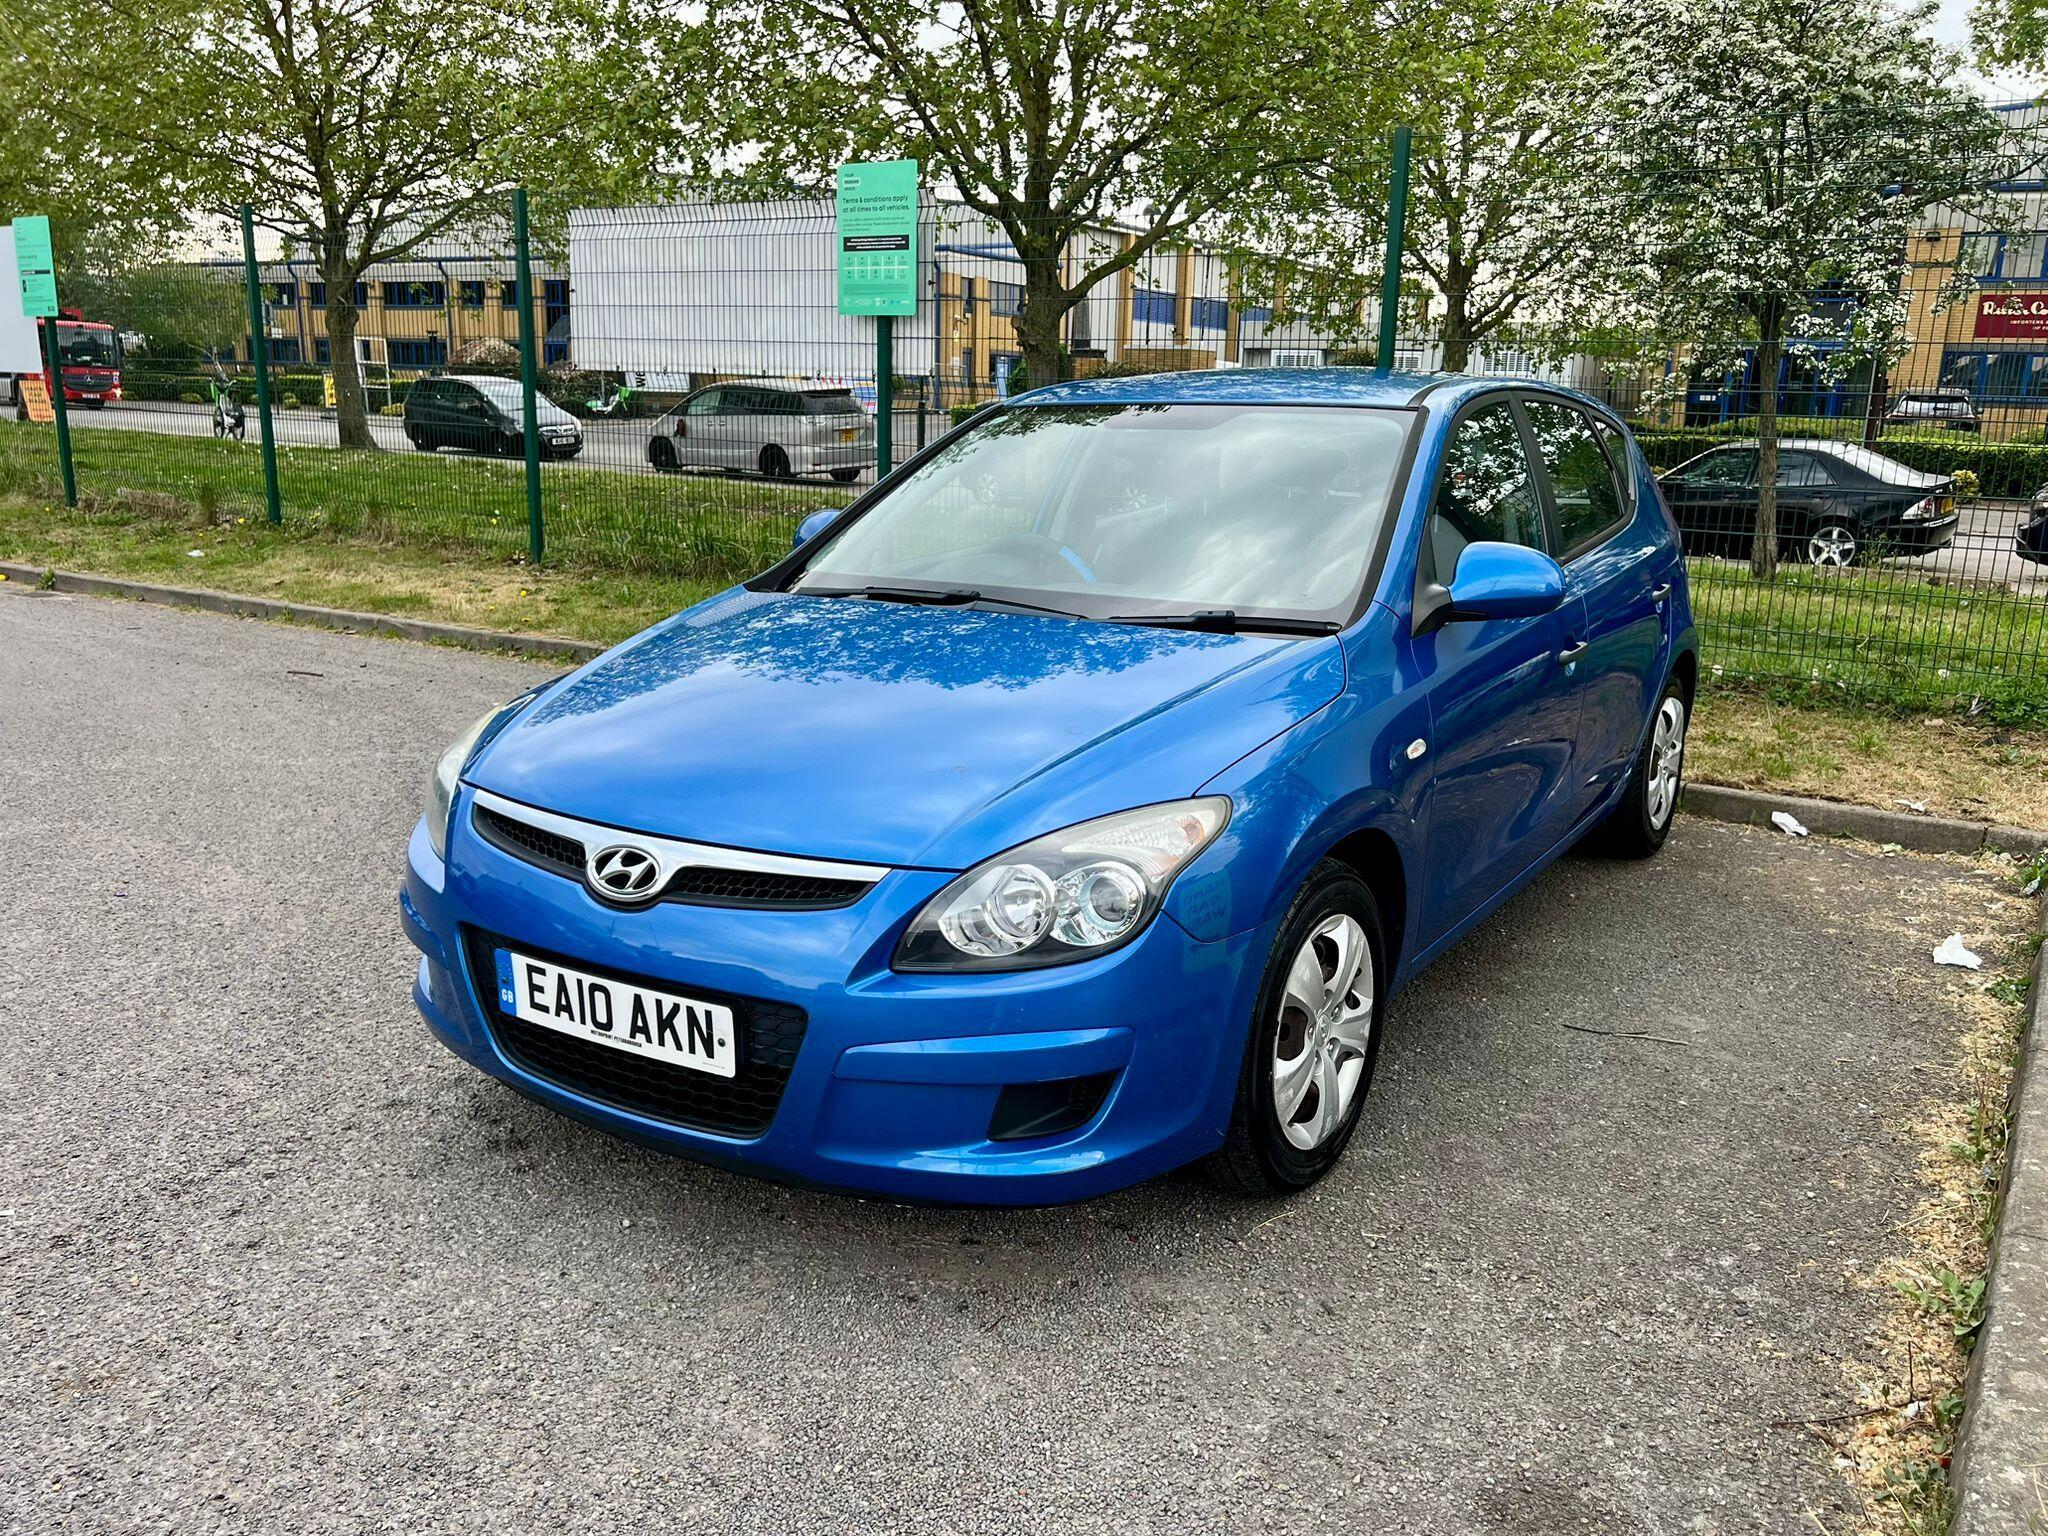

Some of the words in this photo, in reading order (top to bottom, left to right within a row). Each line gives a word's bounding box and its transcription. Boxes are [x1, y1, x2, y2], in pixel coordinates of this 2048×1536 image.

[501, 988, 514, 1004] GB
[526, 963, 614, 1032] EA10
[629, 993, 715, 1060] AKN
